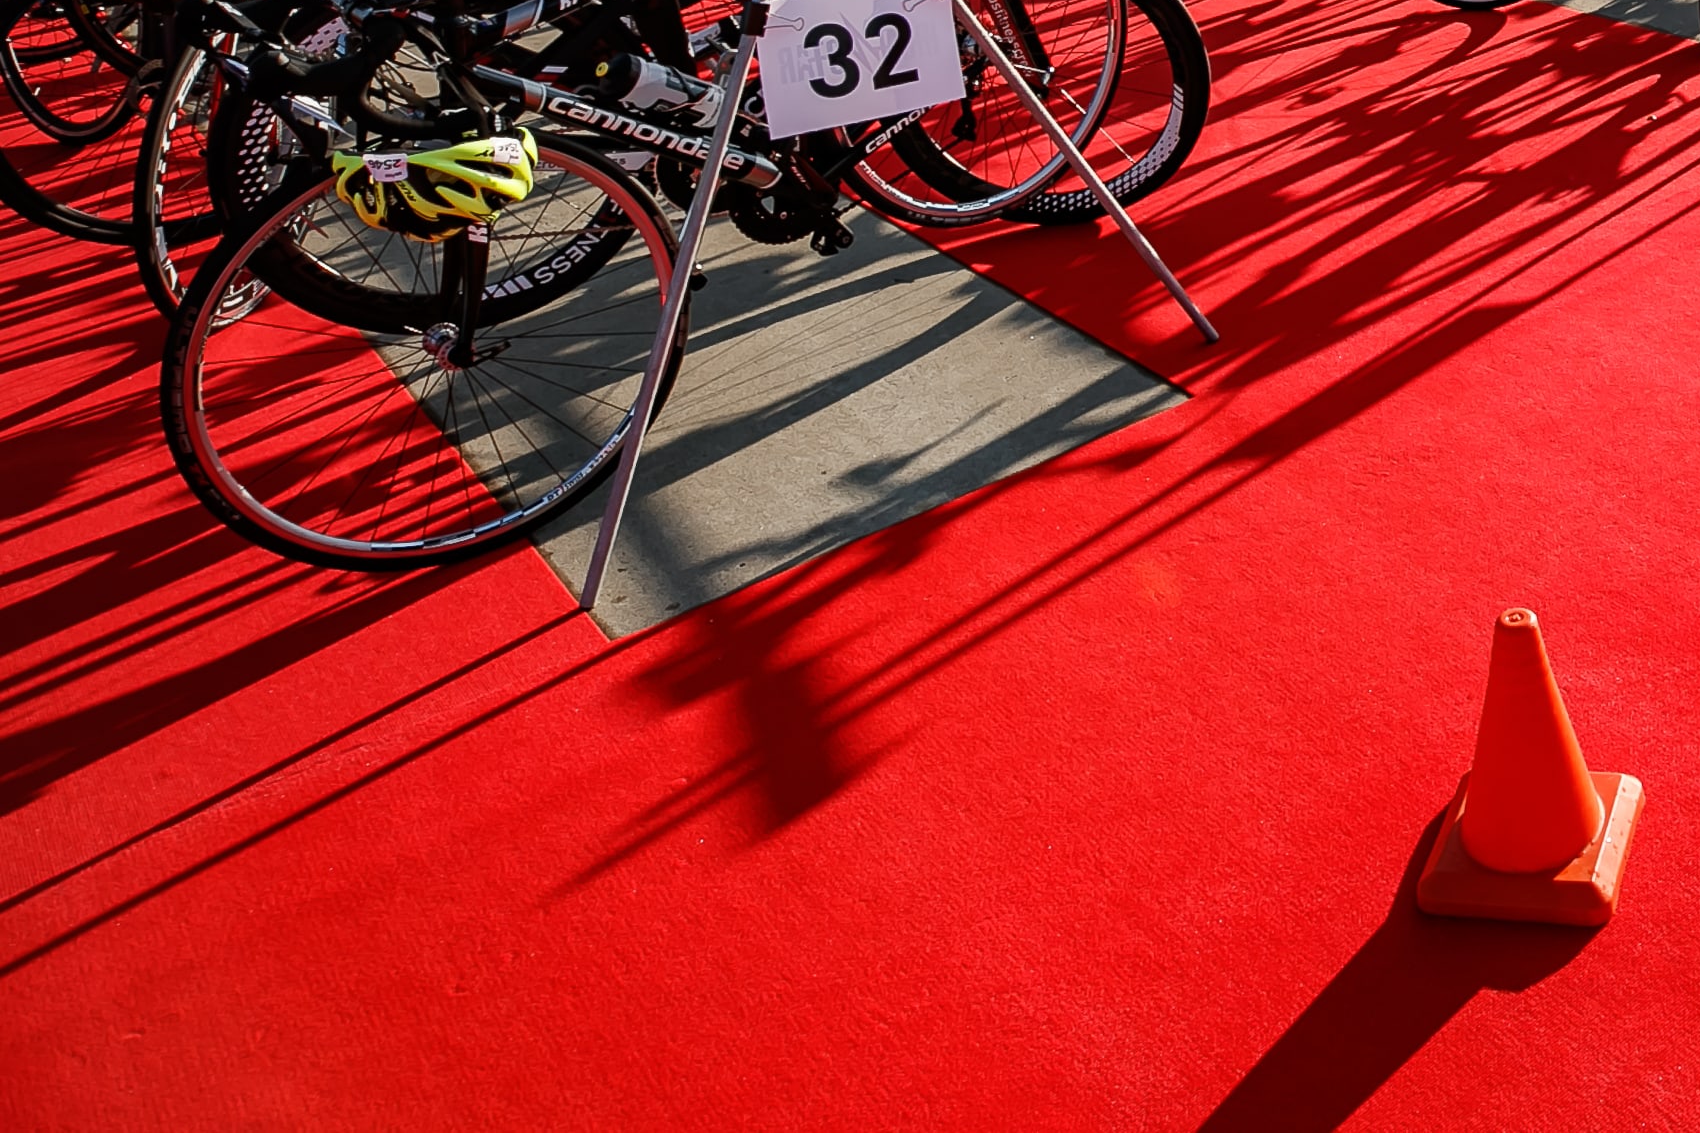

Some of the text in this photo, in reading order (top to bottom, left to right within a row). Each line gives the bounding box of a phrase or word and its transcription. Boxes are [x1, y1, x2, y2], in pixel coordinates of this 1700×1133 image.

[803, 12, 920, 98] 32
[367, 157, 403, 171] 2546
[547, 96, 745, 171] cannondae
